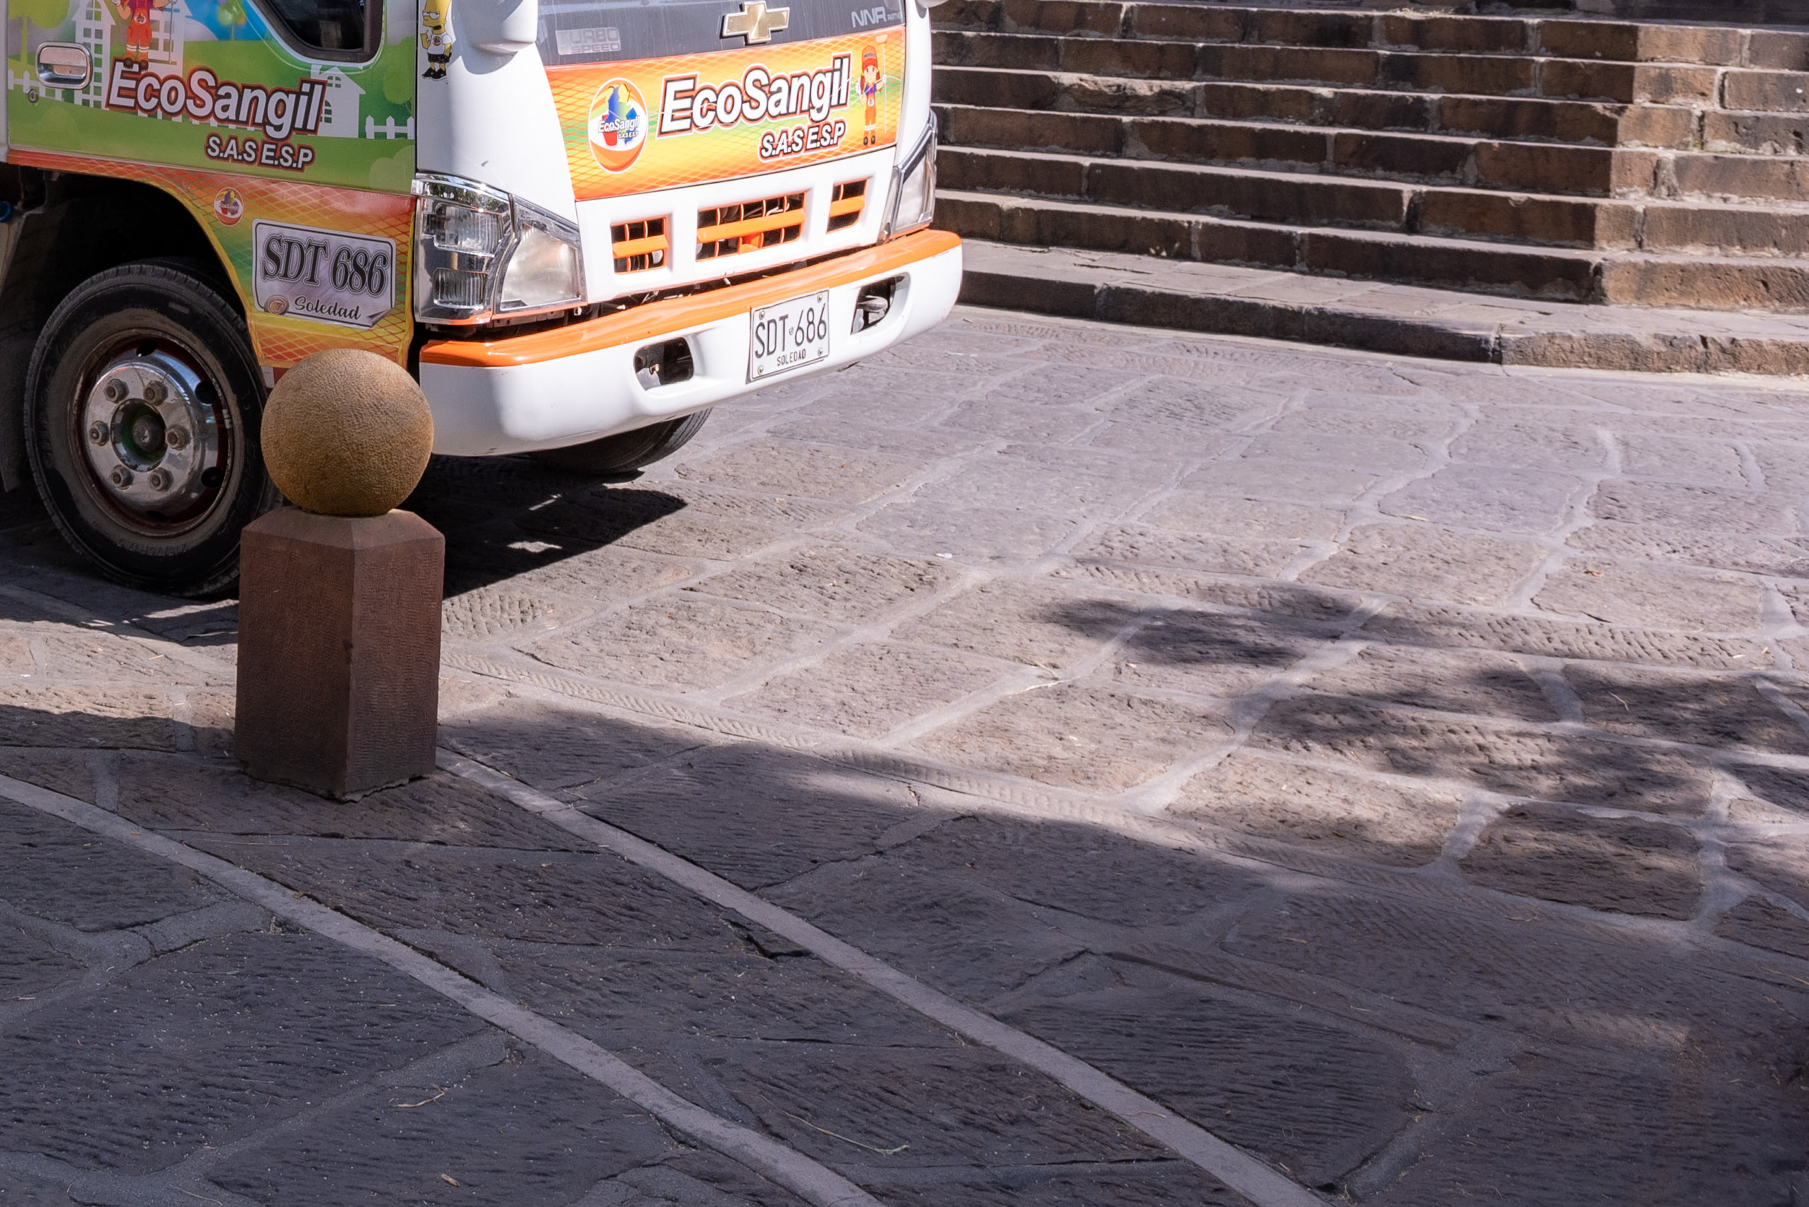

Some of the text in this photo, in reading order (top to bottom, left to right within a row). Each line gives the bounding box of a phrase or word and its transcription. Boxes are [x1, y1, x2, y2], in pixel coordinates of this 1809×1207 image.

[851, 6, 887, 28] NNR
[556, 28, 619, 45] TURBO
[571, 42, 621, 54] SPEED
[107, 59, 326, 141] EcoSangil
[659, 56, 850, 135] EcoSangil
[598, 115, 640, 133] EcoSangil
[206, 135, 314, 170] S.A.S E.S.P
[760, 120, 846, 158] S.A.S E.S.P
[263, 235, 389, 296] SDT 686
[294, 296, 361, 320] Soledad
[755, 302, 827, 359] SDT 686
[776, 348, 807, 366] SOLEDAD
